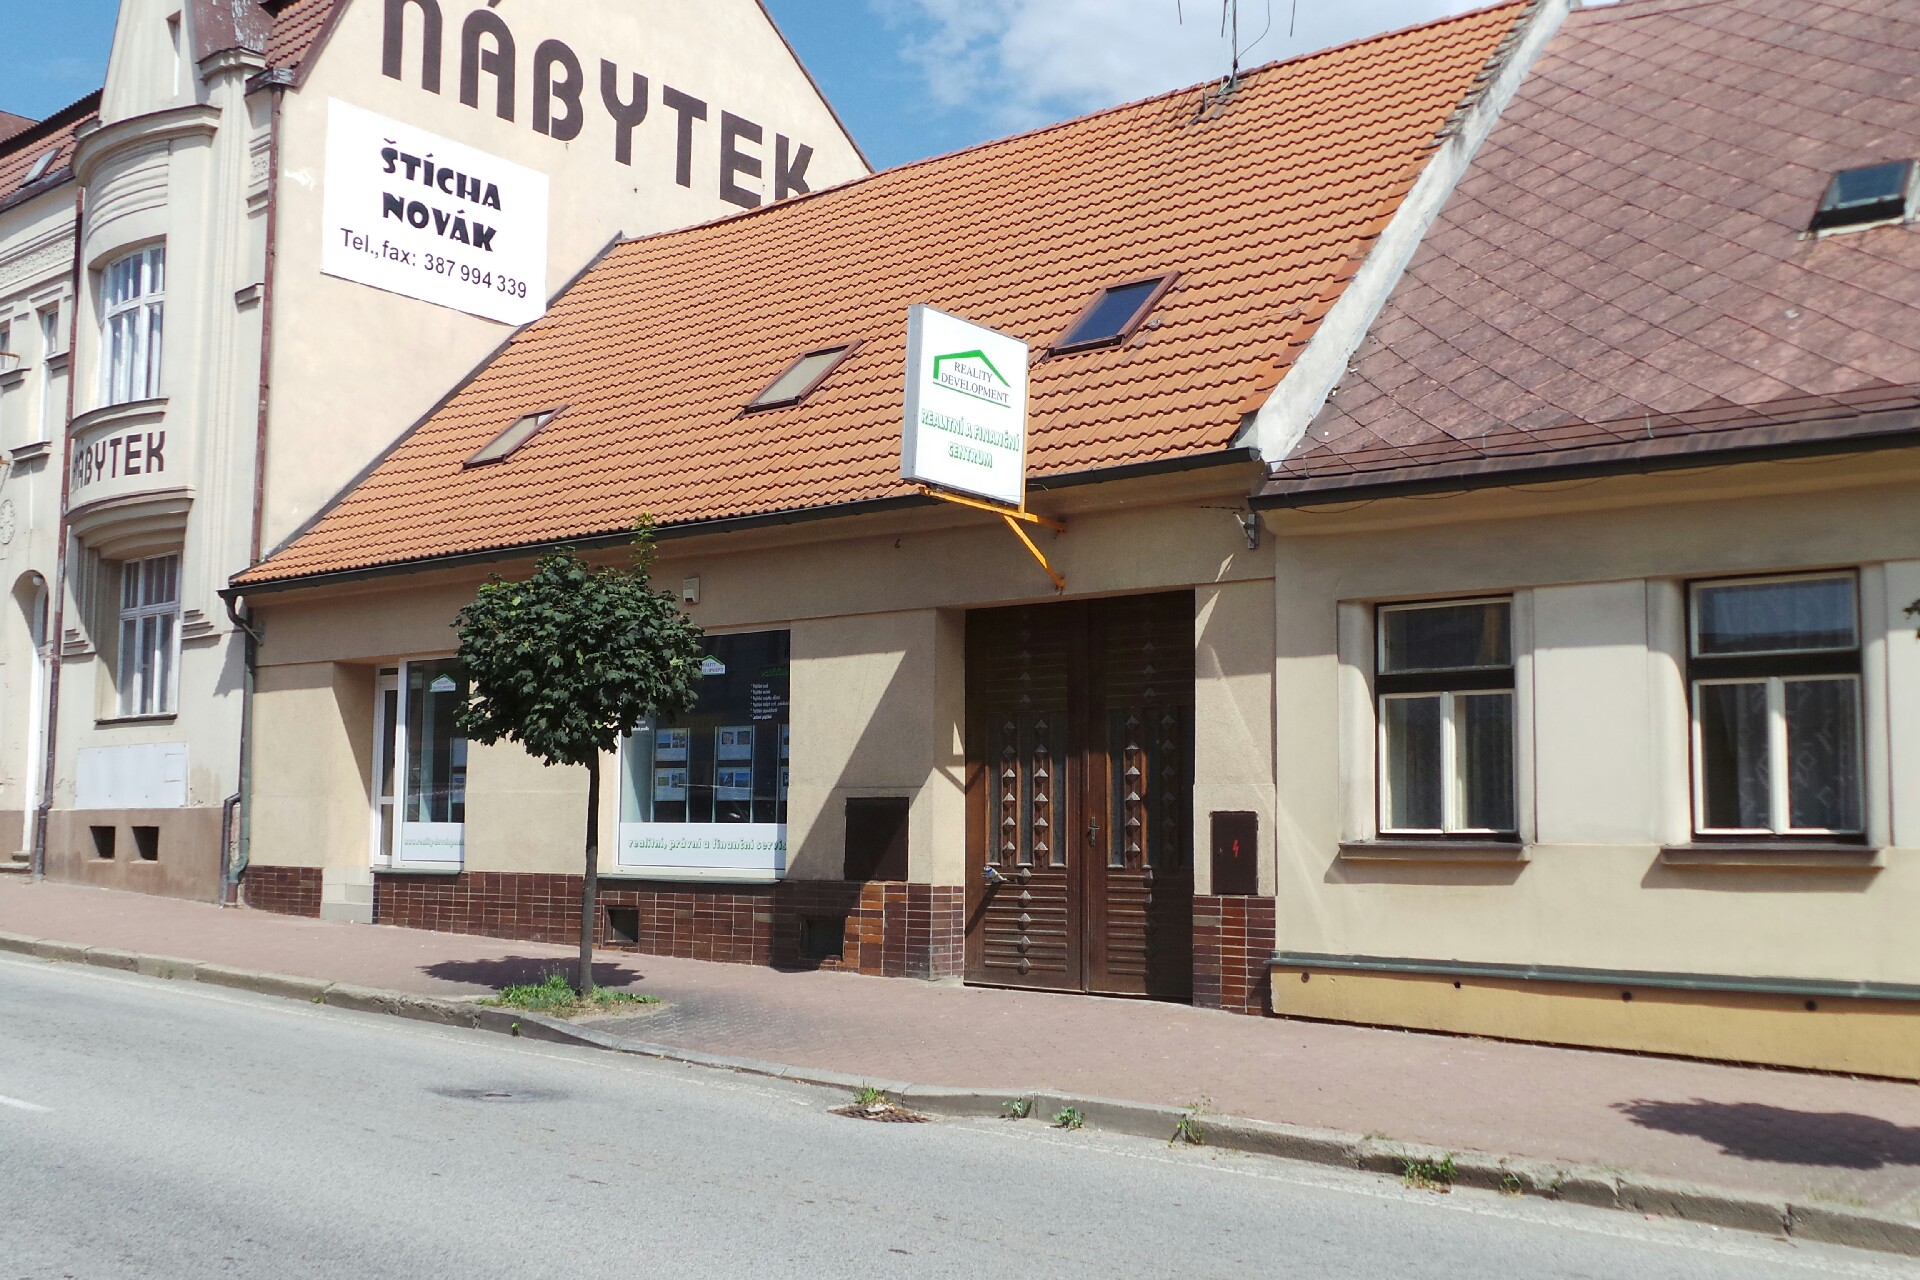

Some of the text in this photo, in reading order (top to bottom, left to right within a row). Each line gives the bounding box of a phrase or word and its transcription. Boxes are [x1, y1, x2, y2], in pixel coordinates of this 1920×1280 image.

[382, 0, 813, 209] NÁBYTEK
[380, 137, 502, 211] ŠTÍCHA
[382, 191, 497, 252] NOVÁK
[423, 253, 455, 277] 387
[460, 264, 492, 288] 994
[496, 274, 527, 298] 339
[941, 372, 1009, 403] DEVELOPMENT
[954, 361, 993, 383] REALITY
[921, 408, 1020, 452] REALITNÍ A FINANČNÍ
[948, 441, 993, 468] CENTRUM
